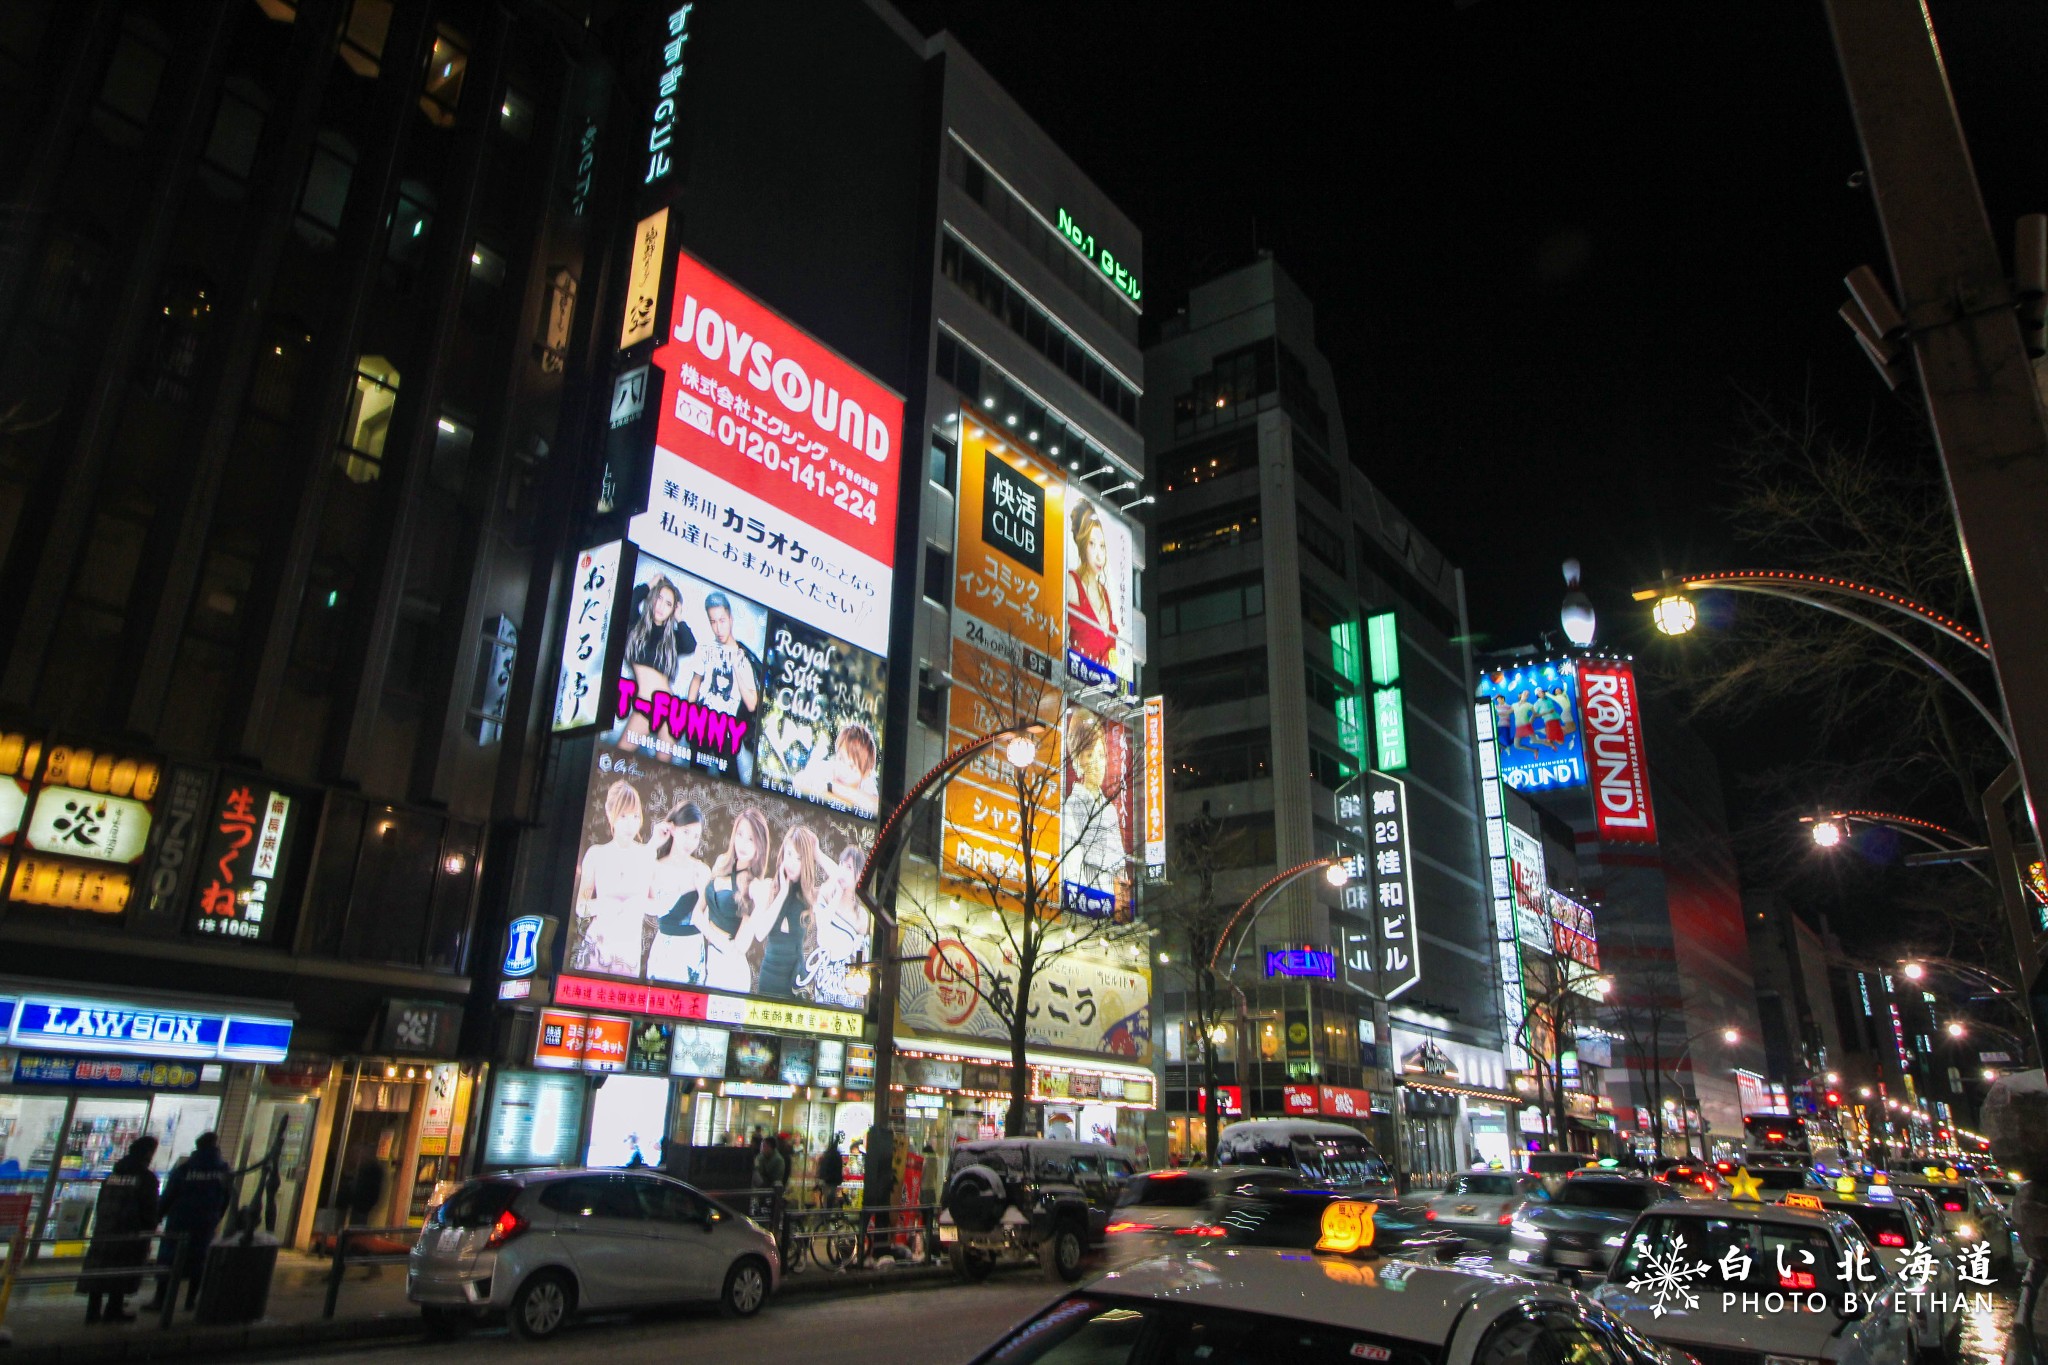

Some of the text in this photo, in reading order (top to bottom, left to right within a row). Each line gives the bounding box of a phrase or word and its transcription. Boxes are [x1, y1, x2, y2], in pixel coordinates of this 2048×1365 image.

[1058, 208, 1095, 259] No.1
[674, 294, 890, 463] JOYSOUND
[717, 418, 877, 525] 0120-141-224
[992, 471, 1037, 528] 快活
[991, 512, 1036, 554] CLUB
[960, 571, 1060, 637] インターネット
[984, 555, 1040, 601] コミック
[775, 630, 836, 672] Royal
[617, 678, 747, 755] T-FUNNY
[777, 687, 823, 721] Club
[1585, 673, 1648, 829] ROUND1
[1619, 677, 1645, 809] SPORTS ENTERTAINMENT
[201, 786, 256, 917] 生つくね
[1373, 789, 1408, 972] 第23桂和ビル
[219, 920, 259, 939] 100円
[43, 1007, 202, 1044] LAWSON
